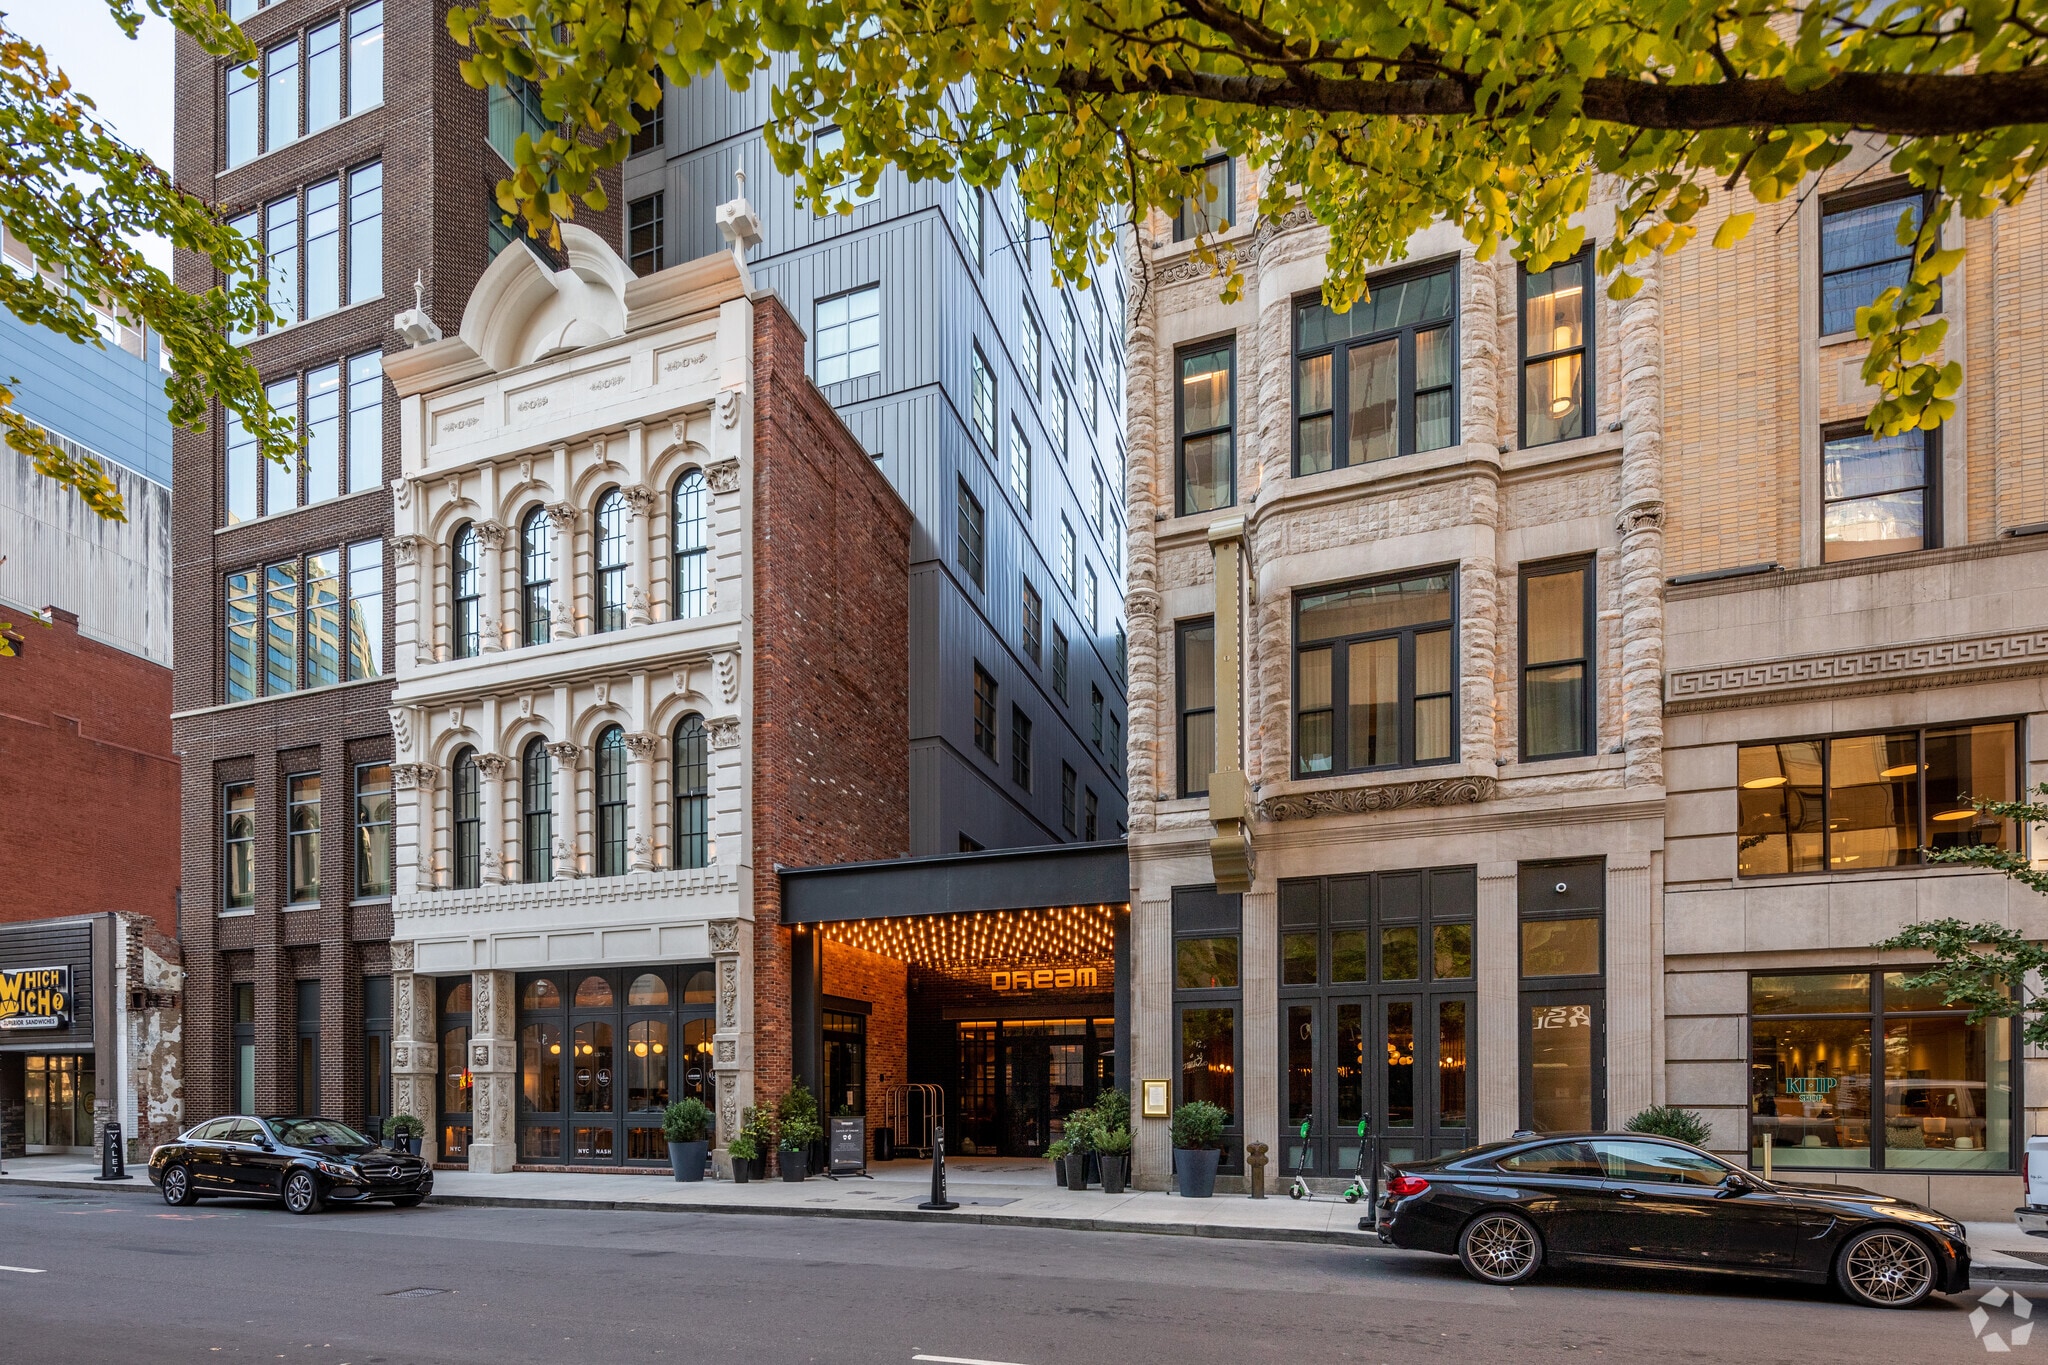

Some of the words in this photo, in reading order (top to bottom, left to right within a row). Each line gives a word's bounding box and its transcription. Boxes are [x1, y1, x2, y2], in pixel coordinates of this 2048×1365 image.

[0, 970, 59, 1001] WHICH
[1799, 1094, 1823, 1102] SHOP
[110, 1134, 119, 1173] VALET
